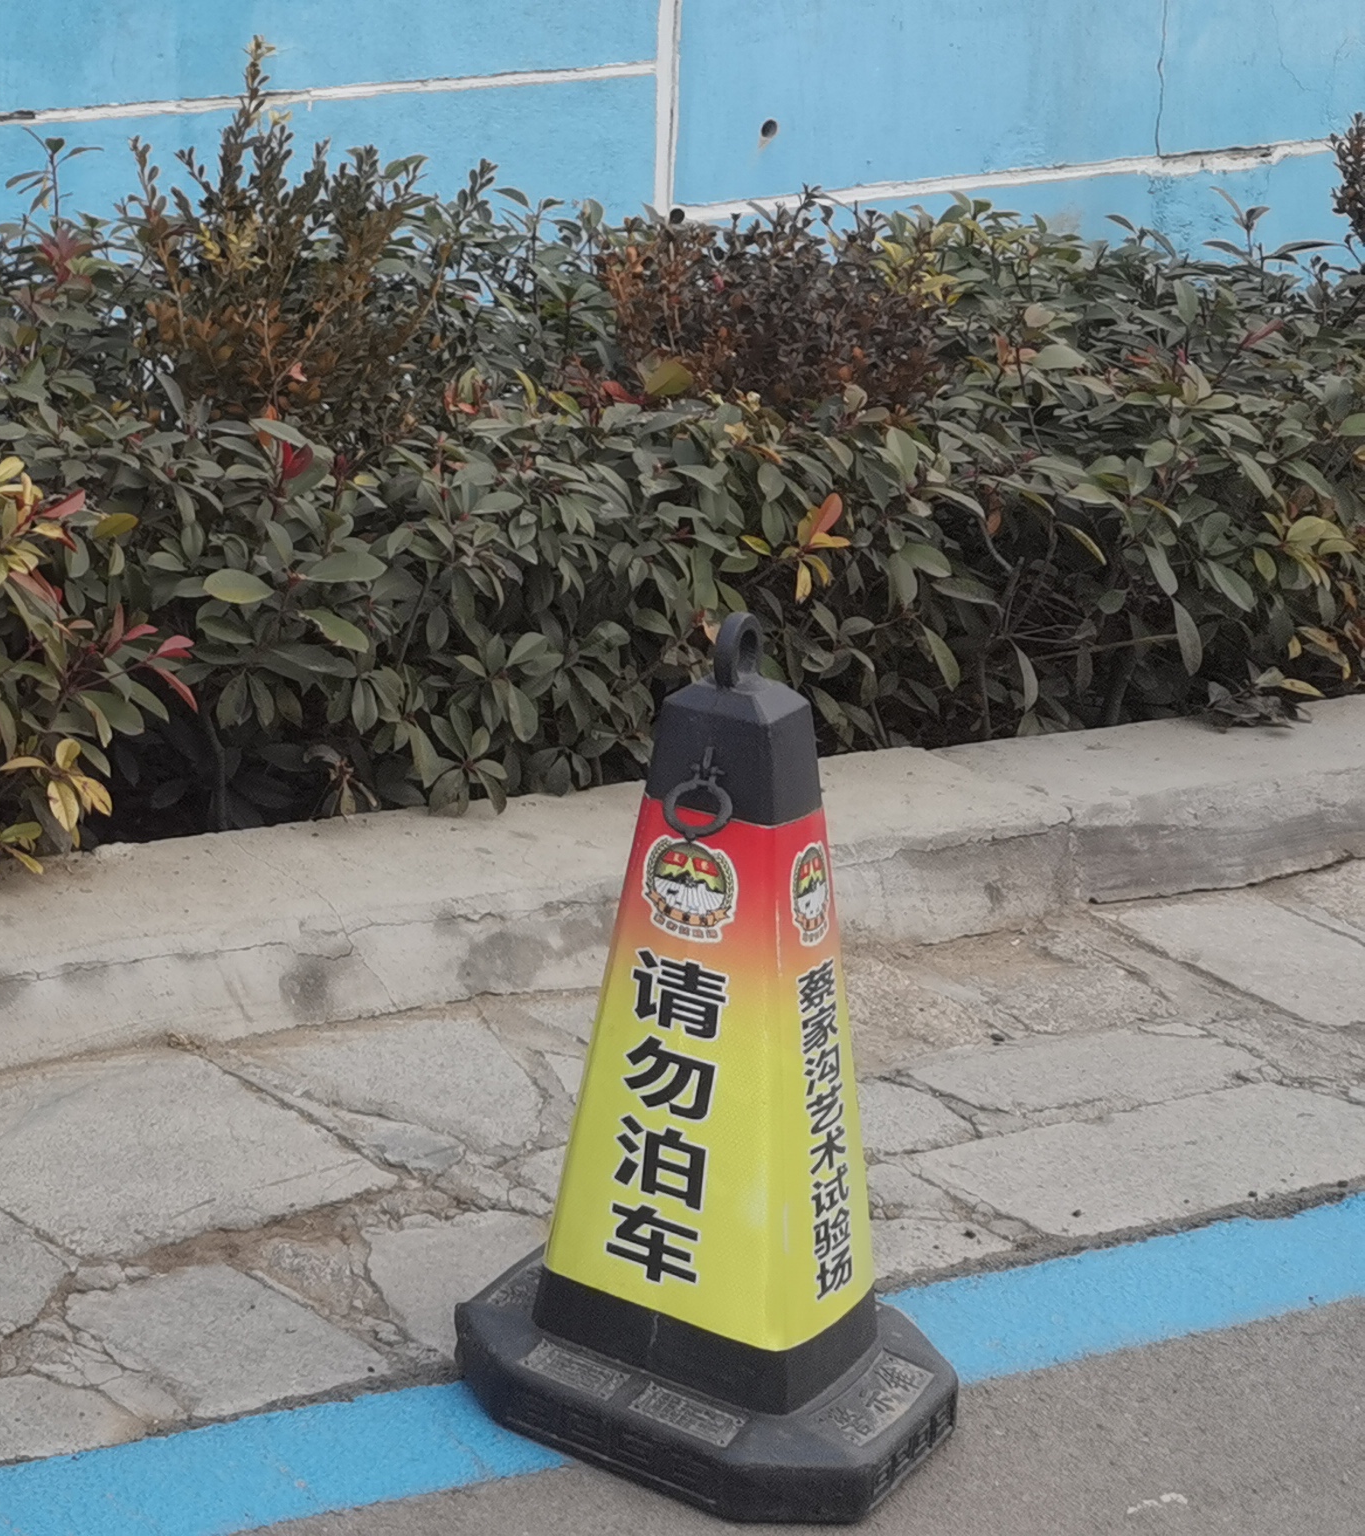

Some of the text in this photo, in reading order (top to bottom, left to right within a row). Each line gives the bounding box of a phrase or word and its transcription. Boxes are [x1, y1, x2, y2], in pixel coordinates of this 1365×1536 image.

[607, 948, 728, 1285] 请勿泊车
[795, 958, 854, 1303] 蔡家沟艺术试验场
